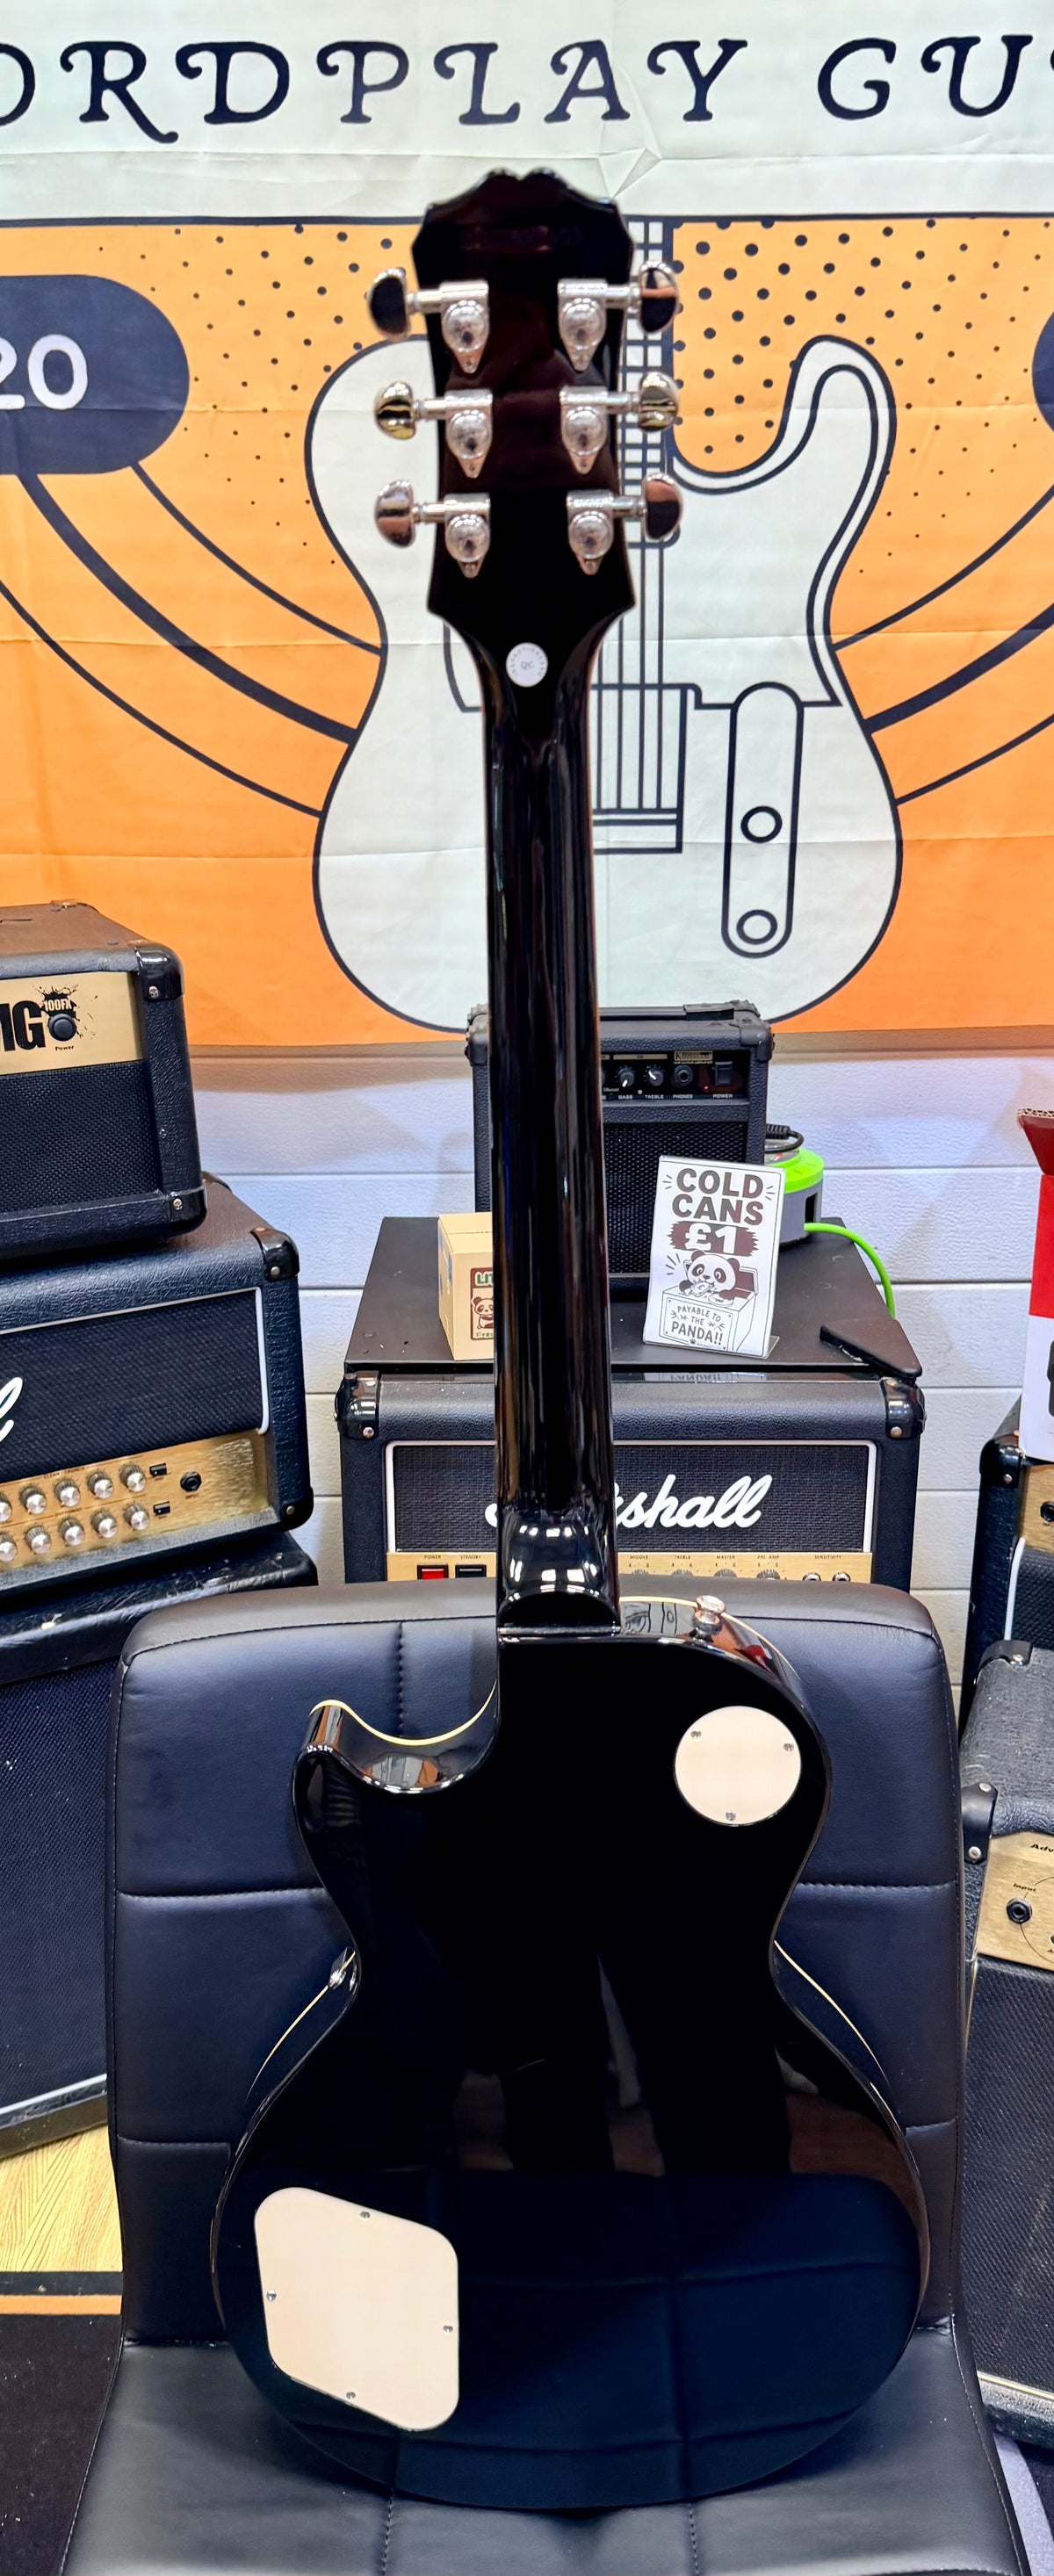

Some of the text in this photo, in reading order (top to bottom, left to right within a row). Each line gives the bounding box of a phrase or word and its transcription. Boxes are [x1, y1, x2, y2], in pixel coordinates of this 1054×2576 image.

[818, 35, 1054, 120] GU
[44, 998, 73, 1012] 100FX
[676, 1168, 763, 1199] COLD
[672, 1194, 763, 1225] CANS
[684, 1223, 737, 1254] £1
[677, 1306, 721, 1322] PAYABLE TO
[691, 1316, 704, 1325] THE
[671, 1321, 723, 1345] PANDA!!
[1013, 1882, 1036, 1893] Input
